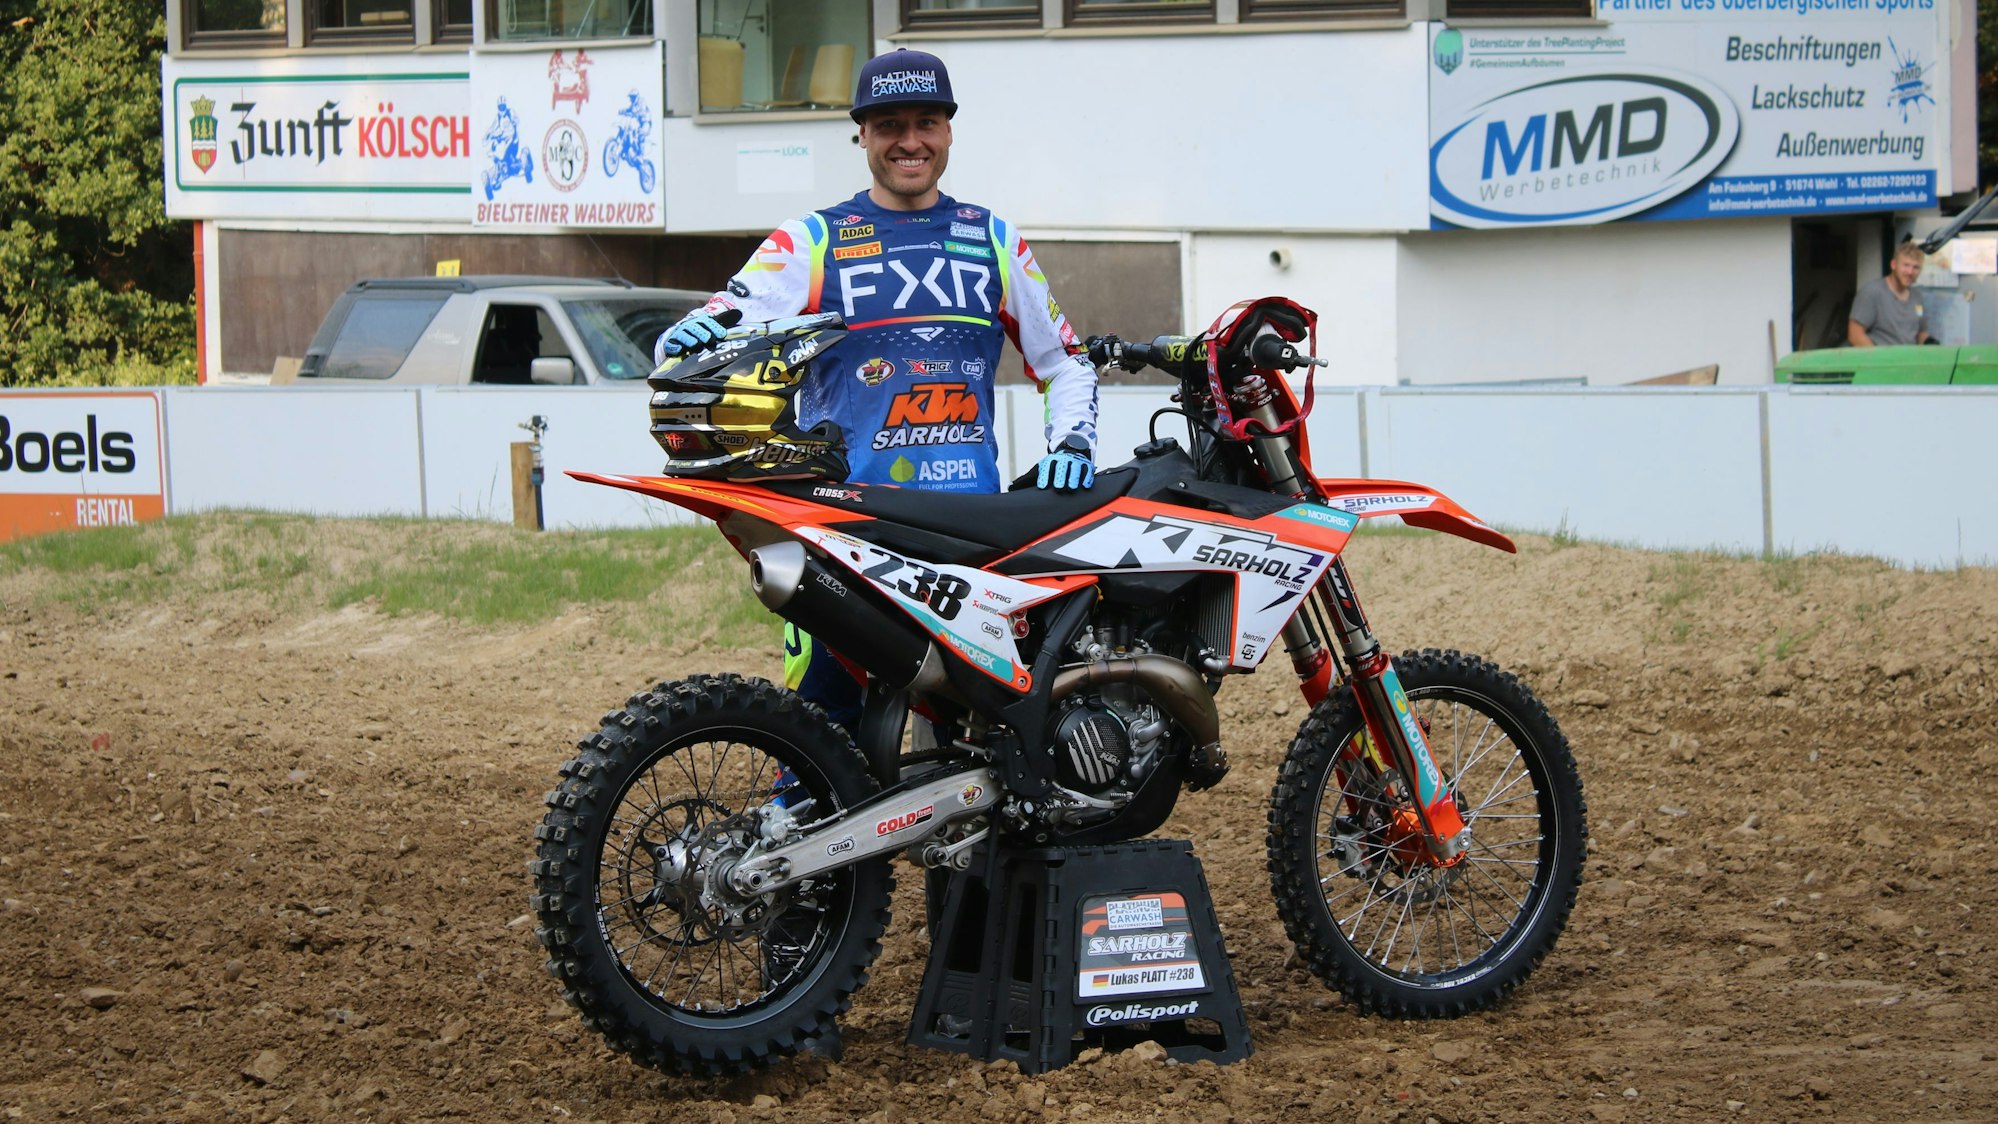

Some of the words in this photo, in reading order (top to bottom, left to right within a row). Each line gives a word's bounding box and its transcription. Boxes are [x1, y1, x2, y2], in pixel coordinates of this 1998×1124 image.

[1527, 37, 1542, 48] des
[1726, 36, 1881, 67] Beschriftungen
[871, 70, 935, 86] PLATINUM
[872, 82, 937, 97] CARWASH
[1752, 84, 1865, 110] Lackschutz
[358, 101, 470, 158] KÖLSCH
[1481, 97, 1667, 180] MMD
[1776, 131, 1924, 160] Außenwerbung
[1479, 157, 1662, 202] Werbetechnik
[477, 203, 569, 223] BIELSTEINER
[575, 202, 656, 224] WALDKURS
[841, 226, 872, 239] ADAC
[956, 245, 987, 256] MOTOREX
[838, 257, 992, 317] FXR
[911, 359, 947, 375] XTRIG
[884, 383, 980, 428] KTM
[718, 435, 745, 444] SHOEI
[872, 425, 985, 450] SARHOLZ
[918, 458, 977, 481] ASPEN
[1344, 495, 1429, 507] SARHOLZ
[76, 498, 135, 527] RENTAL
[1307, 509, 1350, 528] MOTOREX
[1192, 545, 1313, 584] SARHOLZ
[861, 547, 972, 621] 238
[1274, 579, 1302, 591] RACING
[983, 588, 1012, 604] XTRIG
[1243, 631, 1266, 643] benzim
[949, 634, 997, 670] MOTOREX
[876, 812, 916, 835] GOLD
[832, 842, 850, 853] AFAM
[1109, 912, 1161, 924] CARWASH
[1088, 932, 1187, 956] SARHOLZ
[1131, 950, 1185, 962] RACING
[1111, 973, 1139, 986] Lukas
[1141, 969, 1168, 983] PLATT
[1169, 967, 1195, 981] #238
[1086, 1001, 1199, 1026] Polisport
